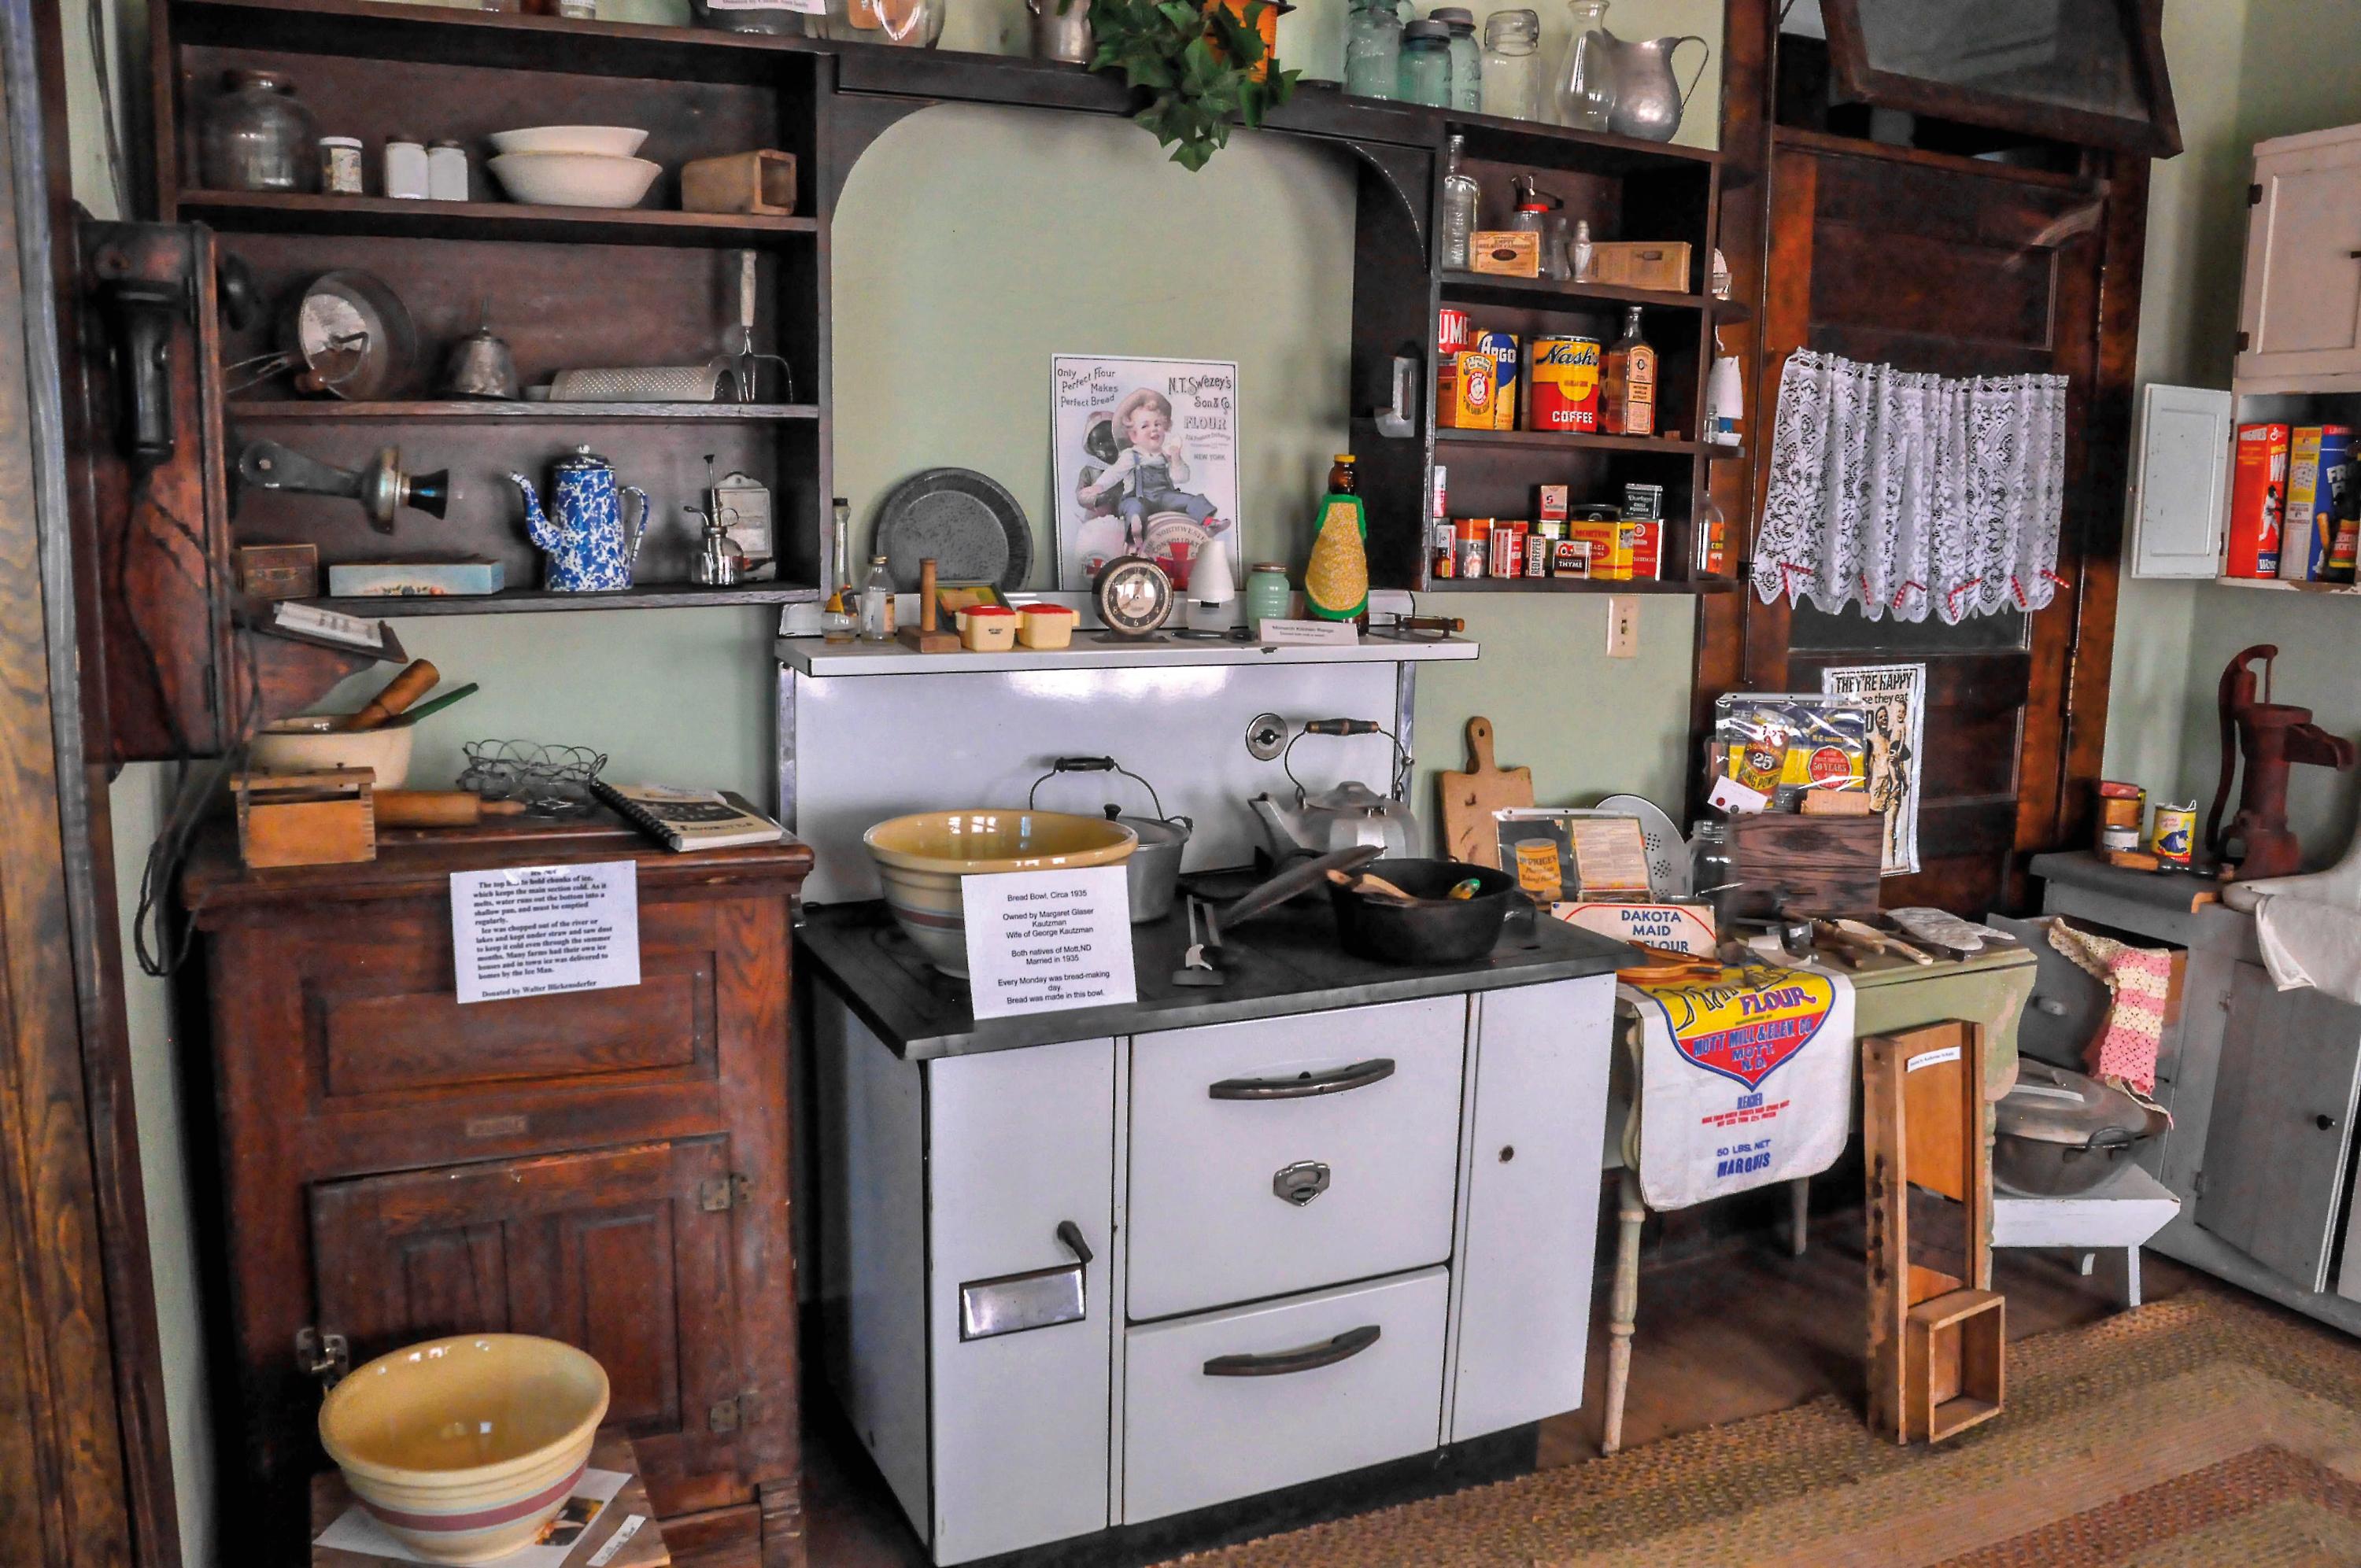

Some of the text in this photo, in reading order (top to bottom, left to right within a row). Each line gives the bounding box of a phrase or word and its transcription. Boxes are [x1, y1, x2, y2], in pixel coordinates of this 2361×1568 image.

[1481, 335, 1517, 363] ARGO
[1058, 367, 1116, 379] Only Flour
[1062, 374, 1118, 393] Perfect Makes
[1061, 395, 1114, 408] Perfect Bread
[1194, 396, 1213, 408] Son
[1184, 416, 1227, 430] FLOUR
[1552, 411, 1593, 423] COFFEE
[1532, 538, 1541, 559] PEPPER
[1836, 673, 1912, 693] THEY'RE HAPPY
[1875, 693, 1894, 706] they
[1895, 692, 1908, 702] eat
[1753, 753, 1773, 770] 25
[1040, 909, 1070, 919] Margaret
[1621, 909, 1682, 923] DAKOTA
[1033, 919, 1066, 928] Kautzman
[1033, 928, 1058, 938] George
[1632, 925, 1672, 936] MAID
[1011, 949, 1028, 957] Both
[1645, 941, 1689, 952] FLOUR
[569, 954, 600, 962] delivered
[1026, 957, 1052, 965] Married
[998, 979, 1018, 987] Every
[1019, 975, 1047, 984] Monday
[1064, 970, 1110, 980] bread-making
[482, 988, 511, 998] Donated
[1738, 986, 1816, 1016] FLOUR
[1693, 1033, 1725, 1057] MOTT
[1728, 1027, 1755, 1048] MILL
[1757, 1025, 1767, 1042] &
[1768, 1020, 1795, 1039] ELEV.
[1717, 1139, 1771, 1157] 50 LBS. NET
[1717, 1153, 1771, 1178] MARQUIS
